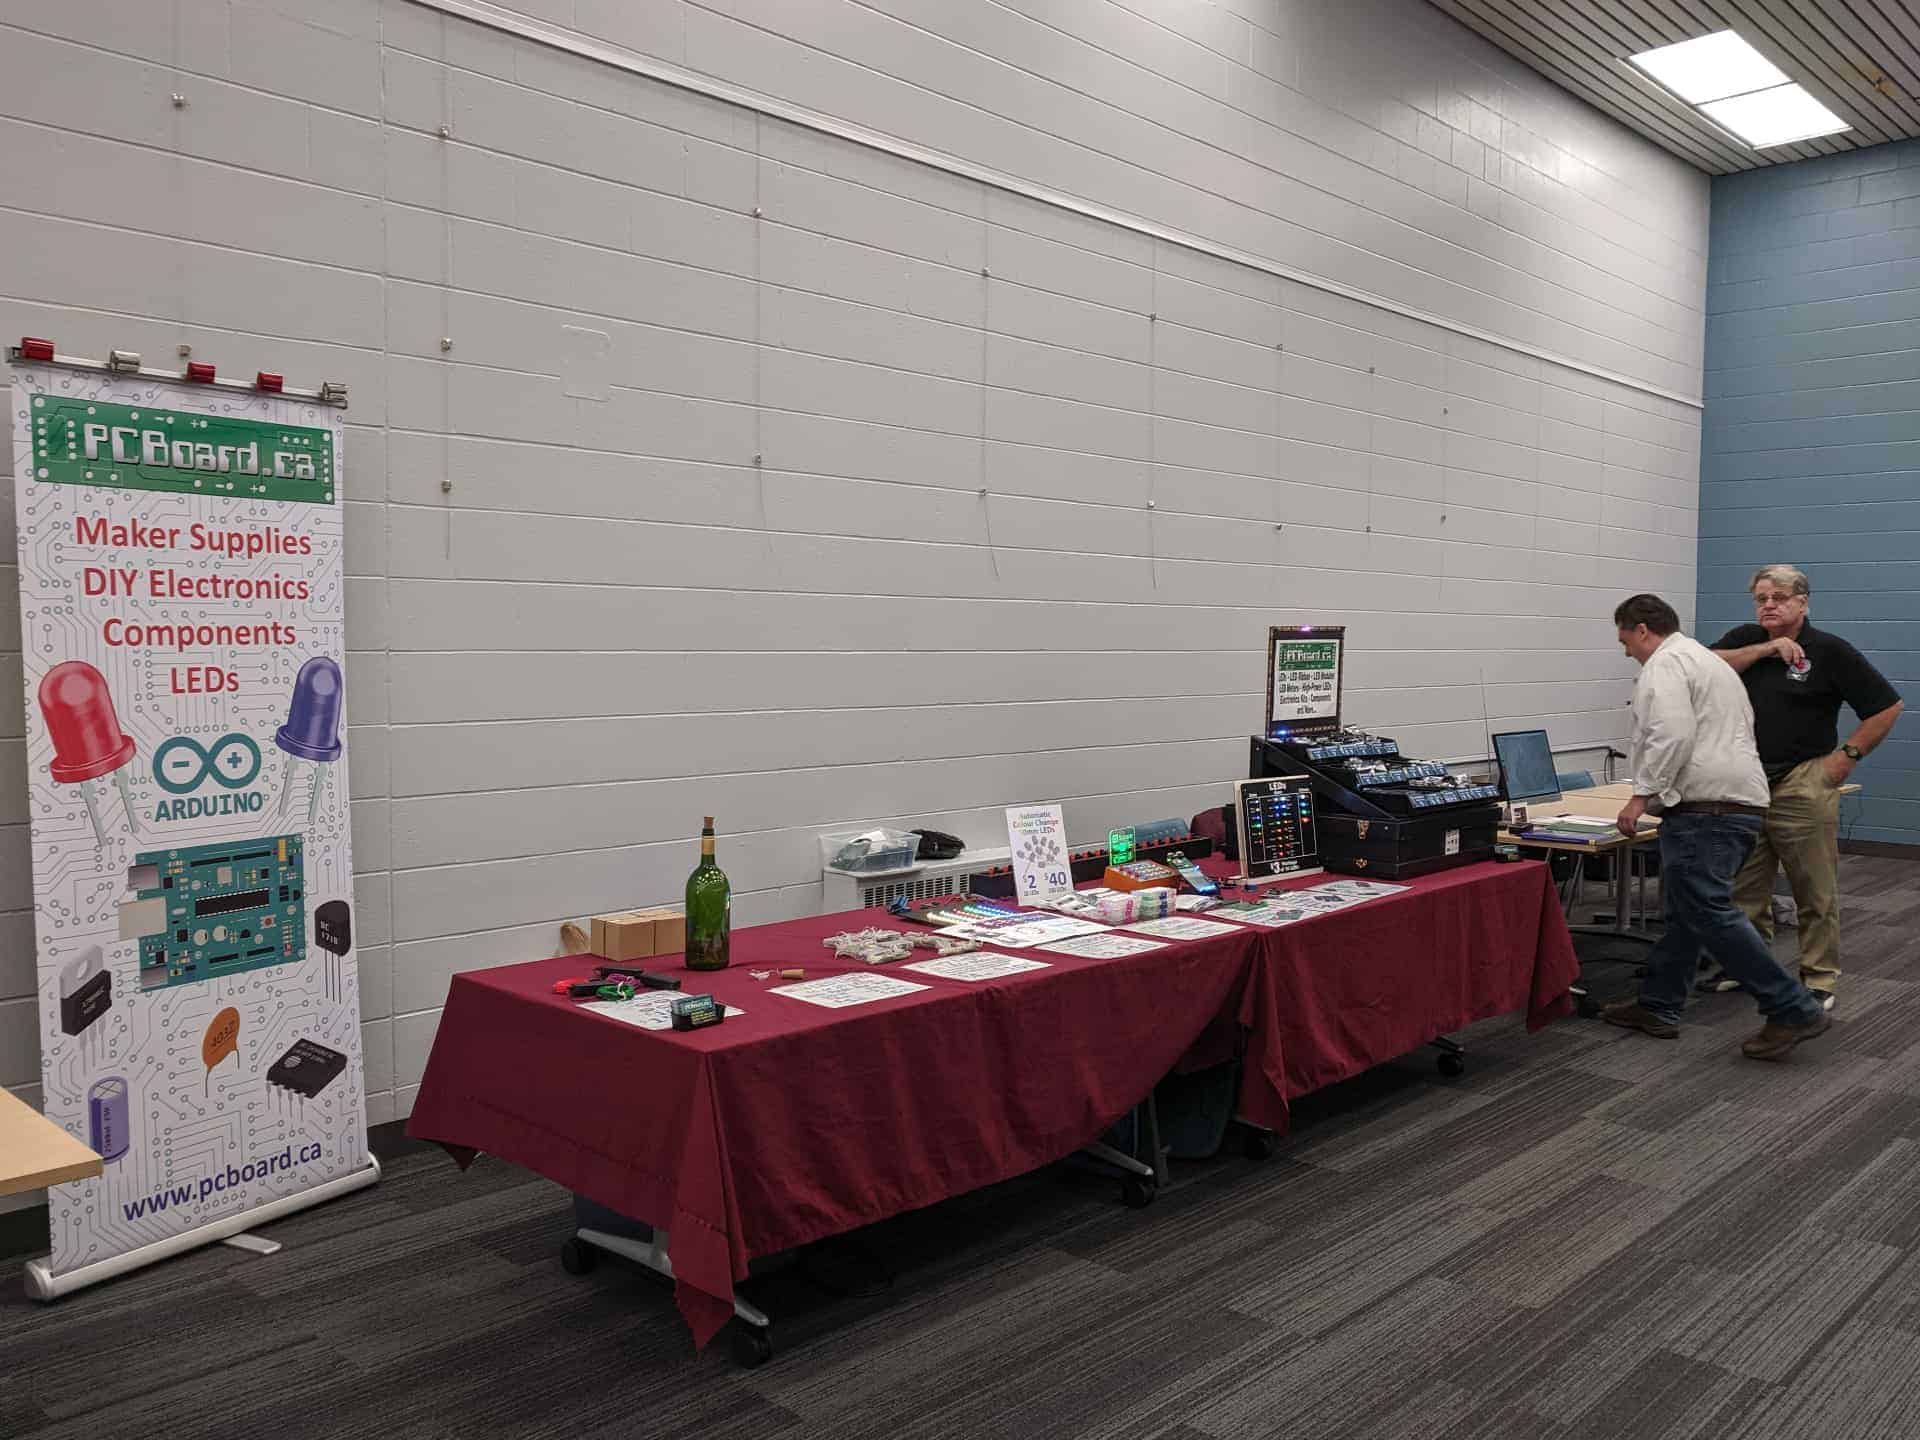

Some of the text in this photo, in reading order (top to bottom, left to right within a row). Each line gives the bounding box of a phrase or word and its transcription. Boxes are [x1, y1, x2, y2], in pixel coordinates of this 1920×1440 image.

[84, 423, 316, 480] PCBoard.ca
[76, 517, 312, 558] Maker Supplies
[84, 567, 309, 600] DIY Electronics
[103, 618, 296, 651] Components
[171, 667, 239, 694] LEDs
[154, 791, 264, 822] ARDUINO
[123, 1142, 322, 1221] www.pcboard.ca
